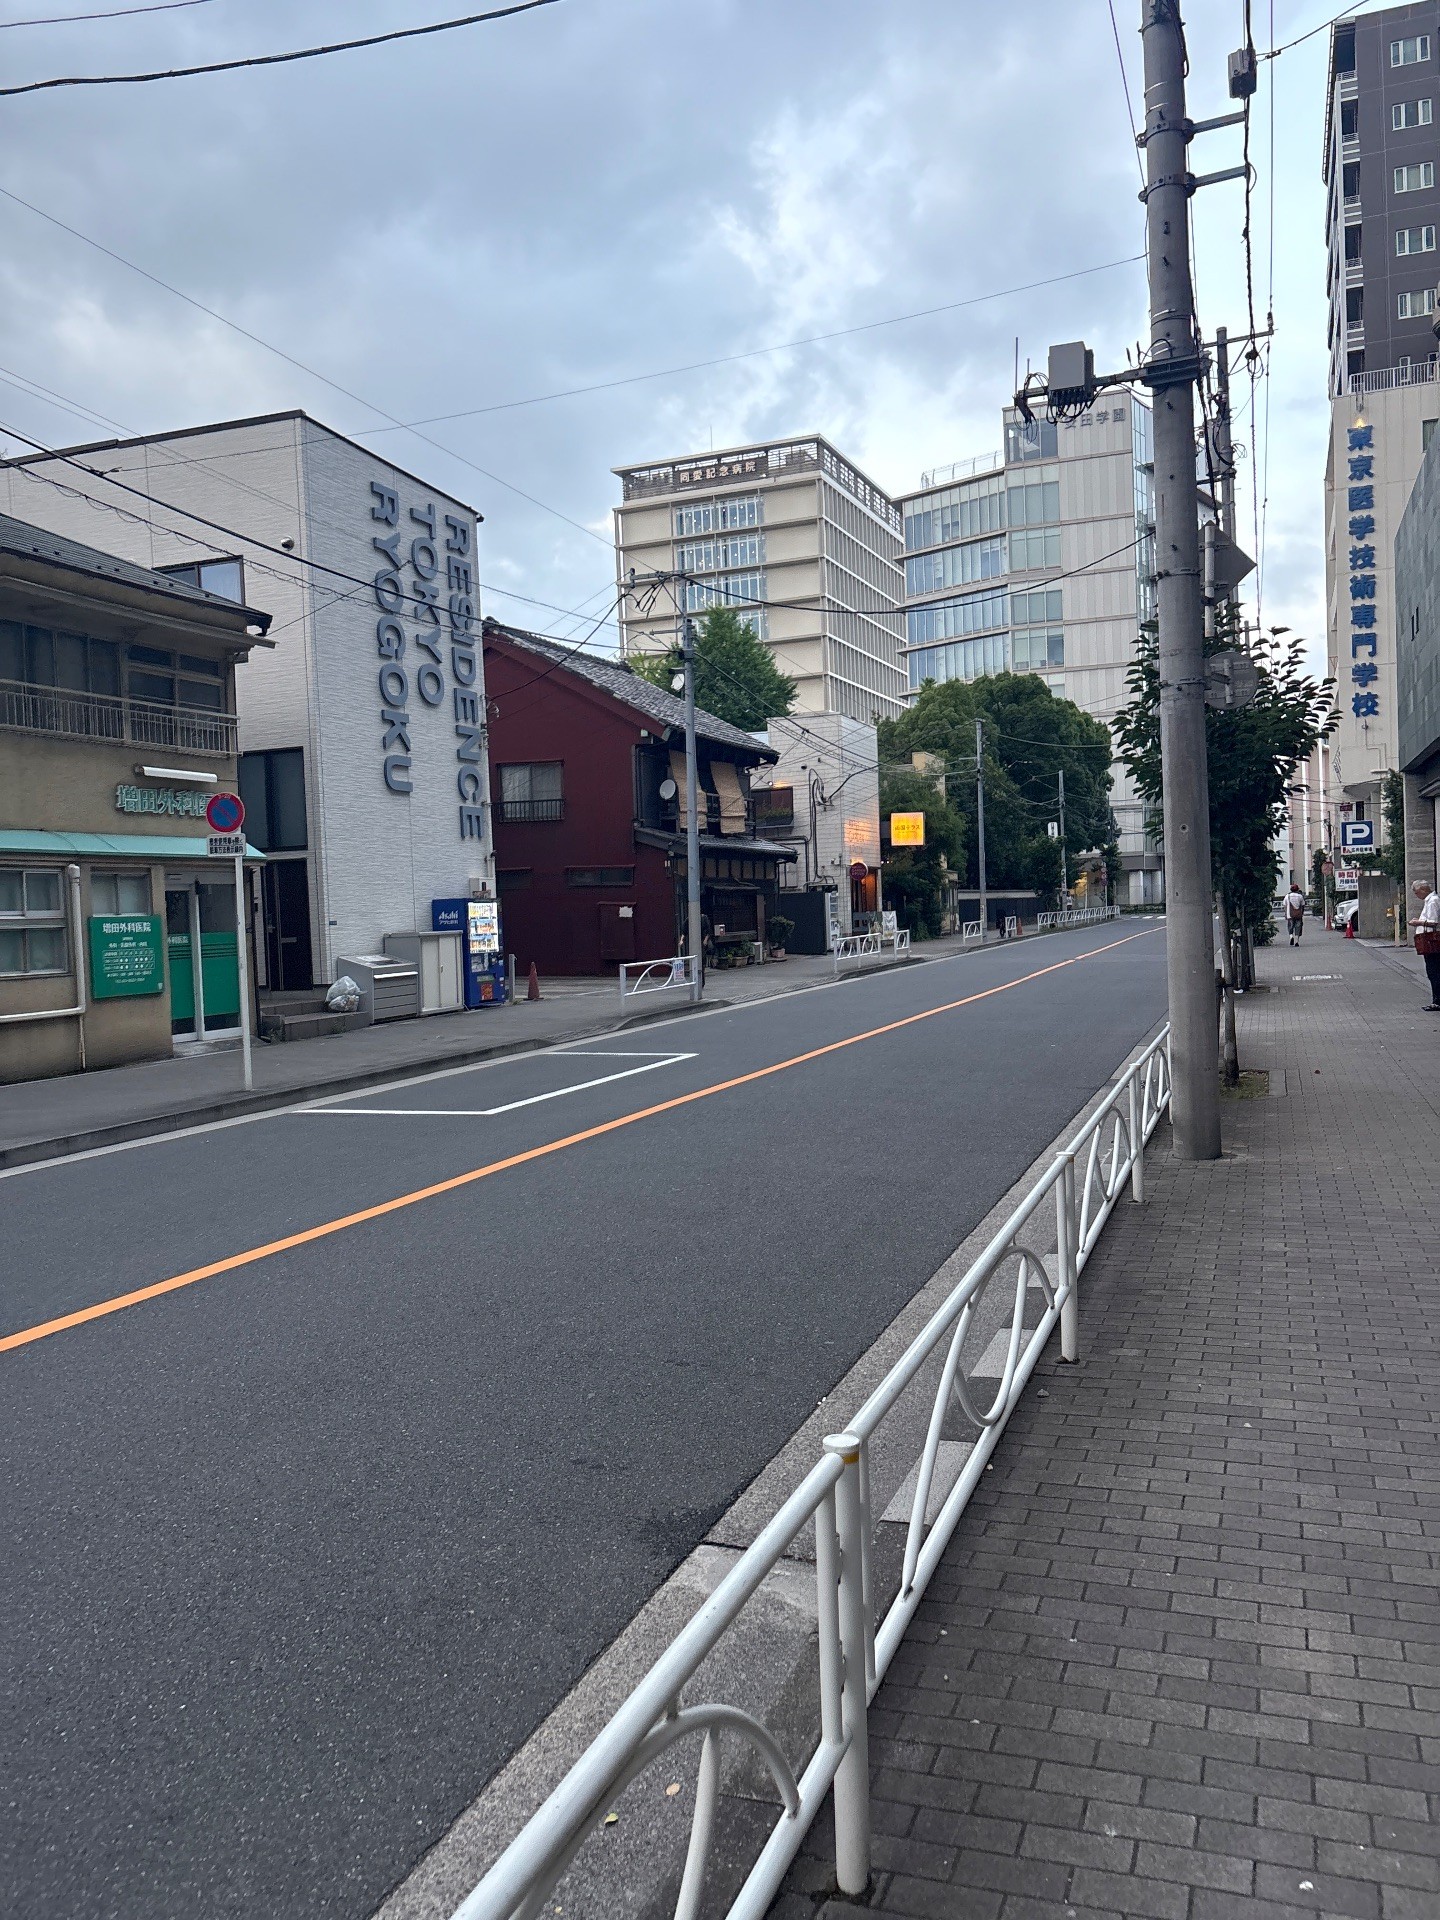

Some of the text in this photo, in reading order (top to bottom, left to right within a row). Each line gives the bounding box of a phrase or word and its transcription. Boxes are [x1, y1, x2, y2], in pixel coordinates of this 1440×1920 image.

[680, 461, 756, 483] 同愛記念病院
[409, 503, 445, 706] TOKYO
[1347, 425, 1379, 718] 東京医学技術専門学校
[370, 480, 414, 793] RYOGOKU
[445, 514, 485, 839] RESIDENCE
[1346, 824, 1370, 844] P
[102, 922, 152, 934] 増田外科医院
[438, 910, 459, 920] Asahi
